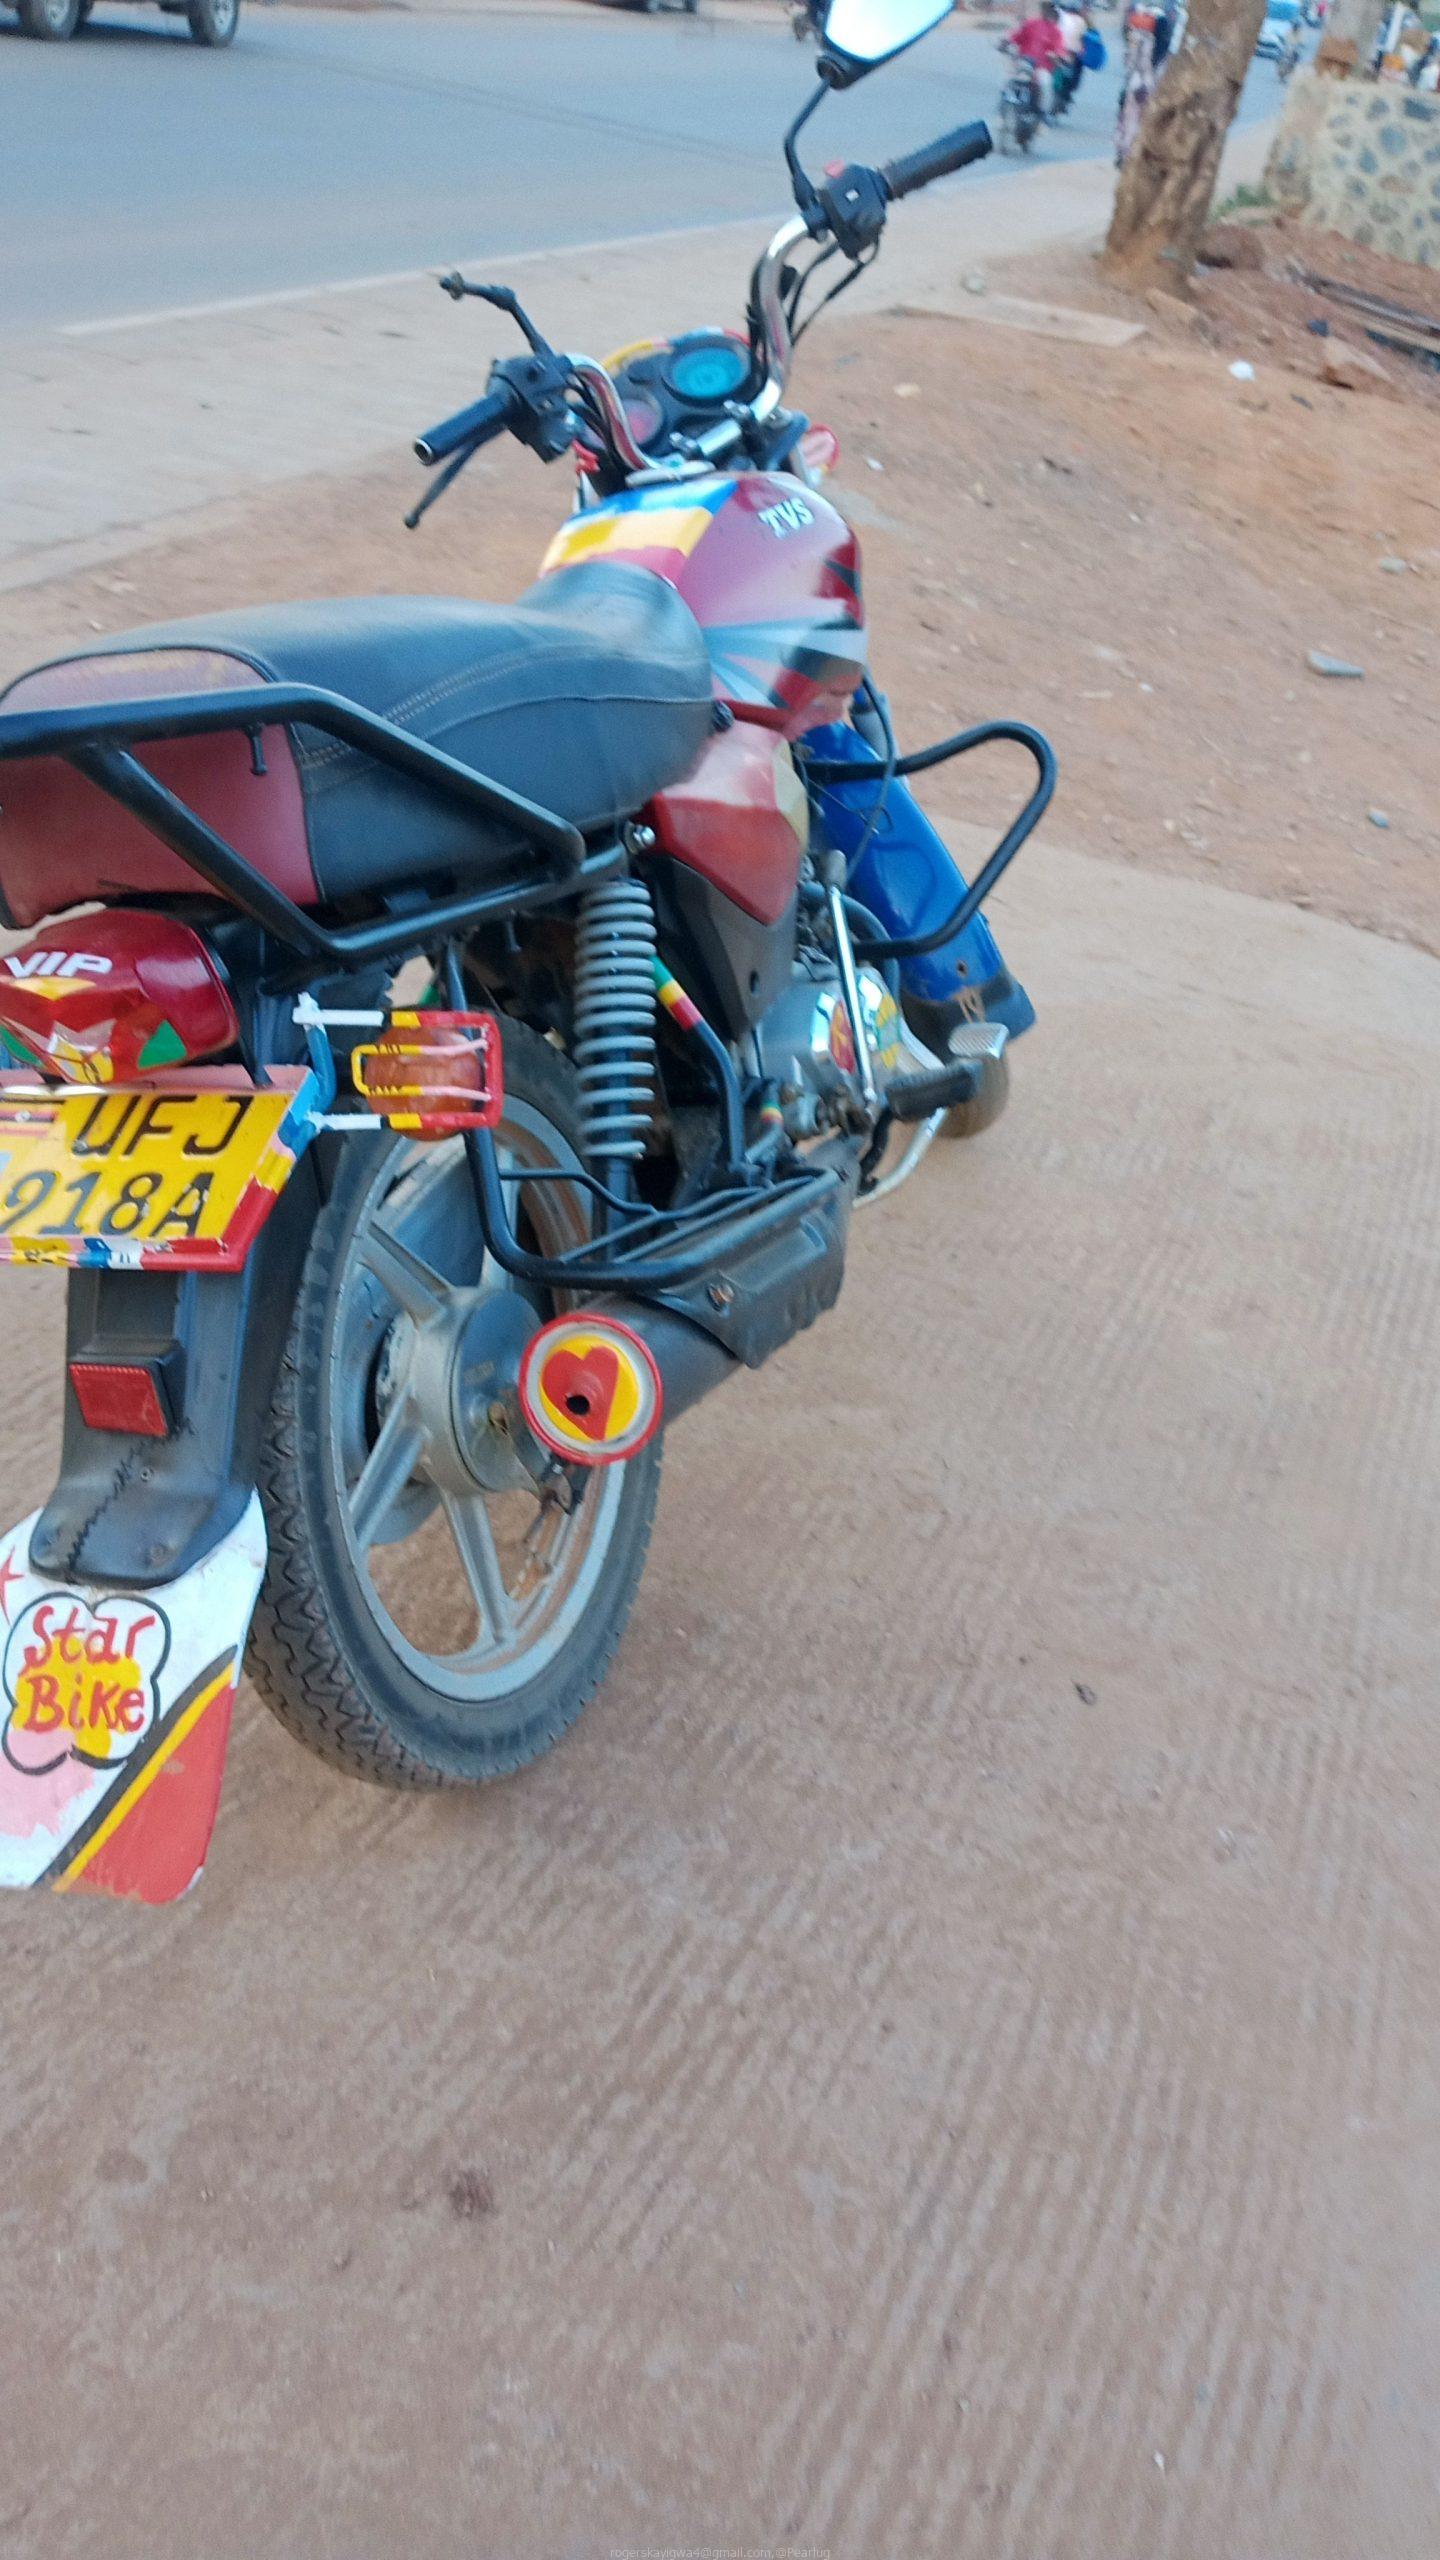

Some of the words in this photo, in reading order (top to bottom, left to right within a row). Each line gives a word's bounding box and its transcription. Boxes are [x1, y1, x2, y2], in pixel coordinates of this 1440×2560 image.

[757, 497, 815, 539] TVS
[3, 950, 113, 979] VIP
[70, 1094, 255, 1156] UFJ
[0, 1170, 215, 1237] 918A
[18, 1605, 156, 1676] Star
[23, 1673, 145, 1734] Bike
